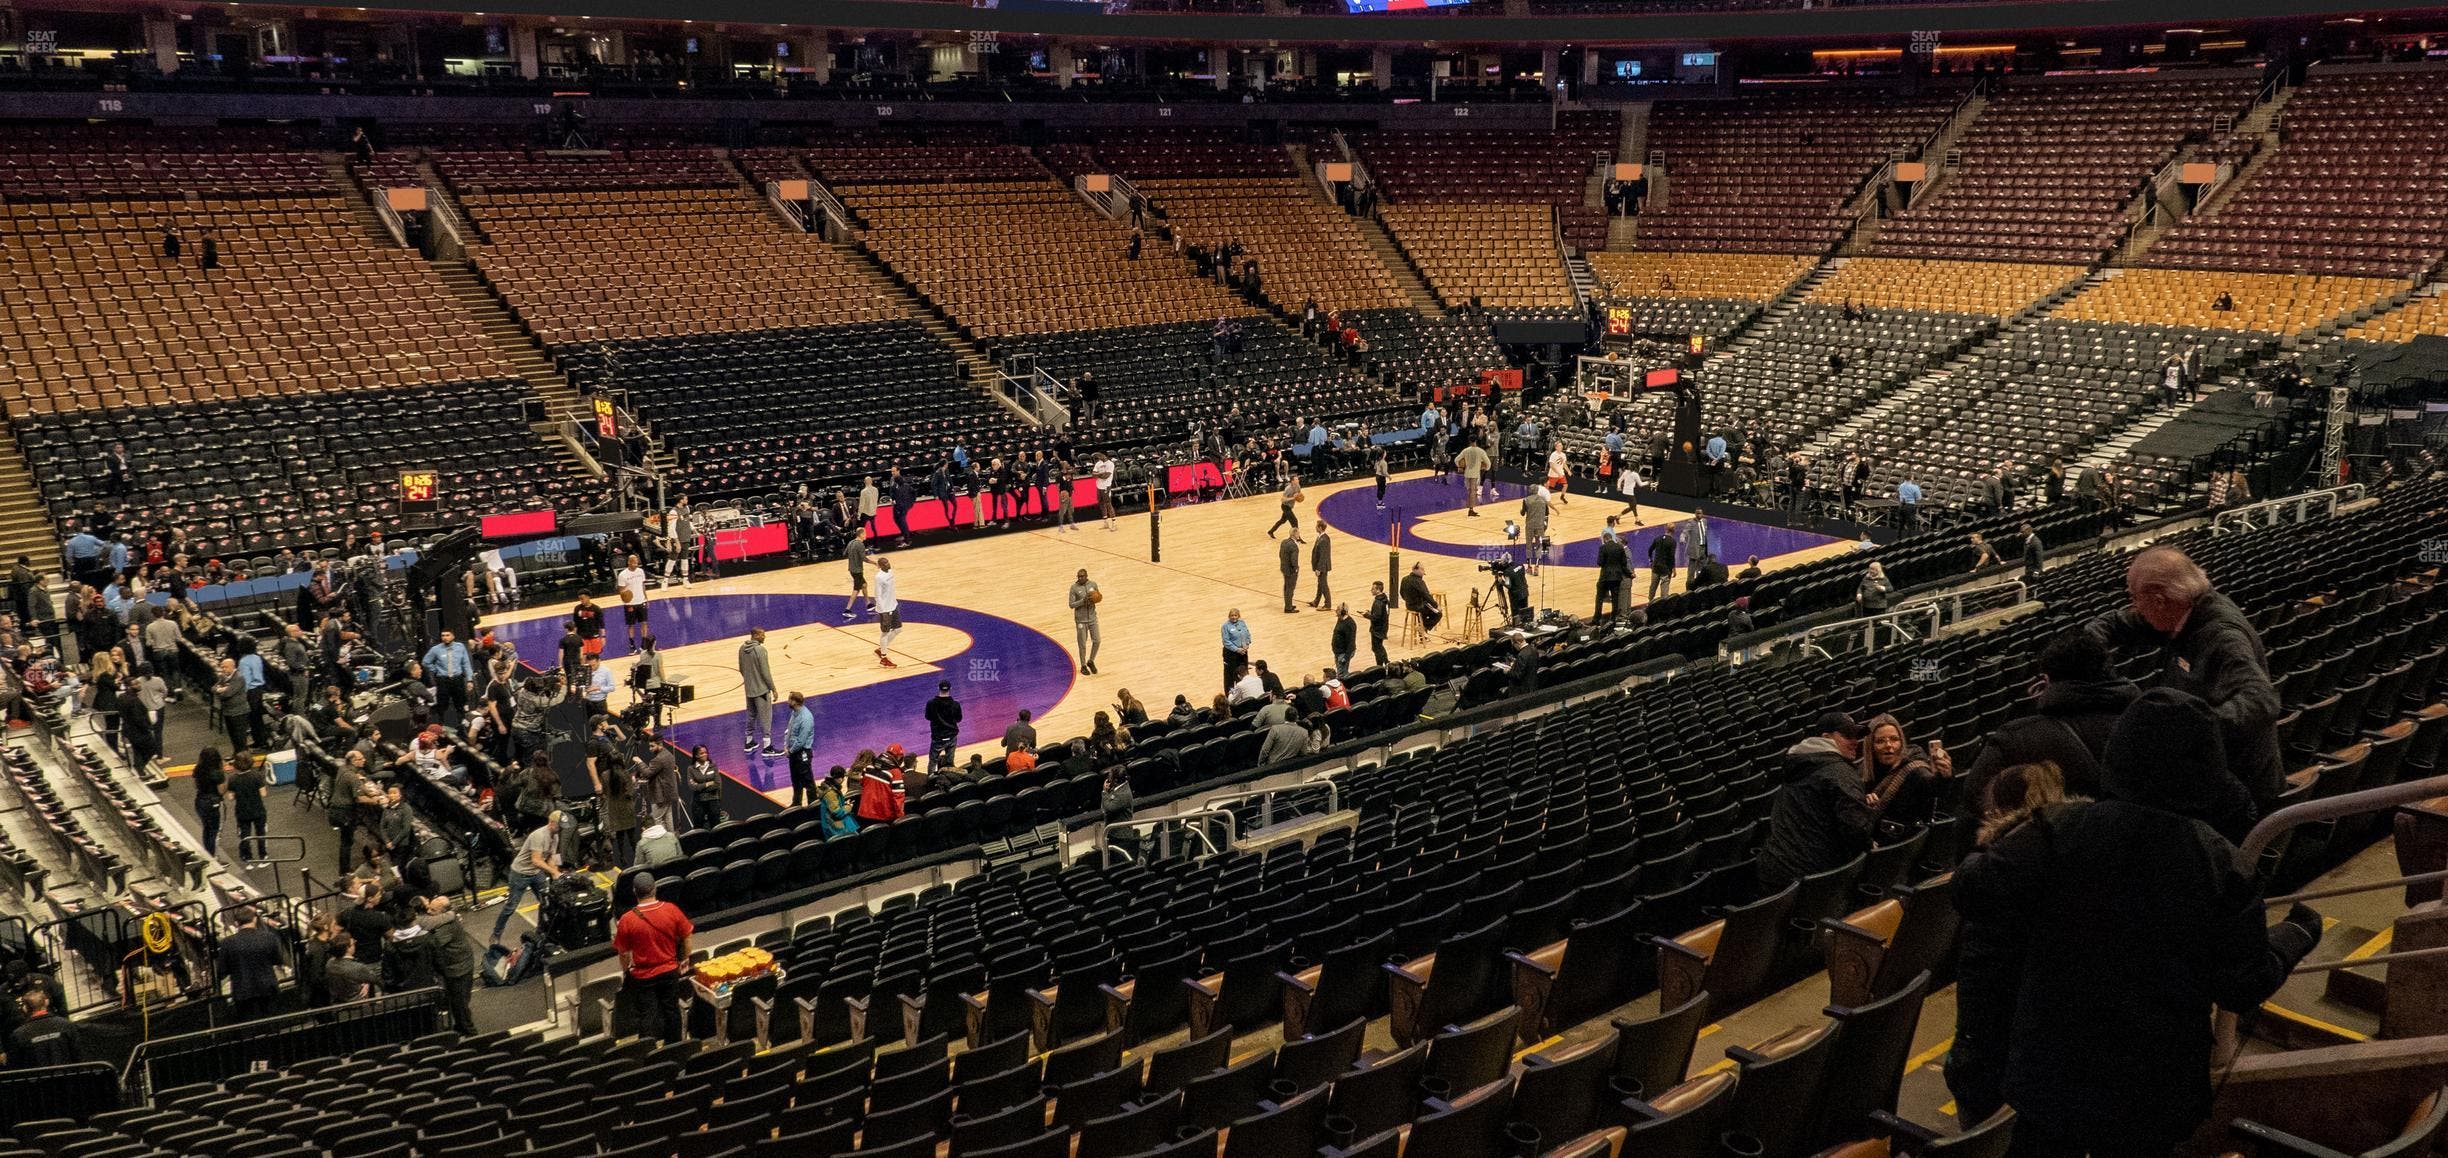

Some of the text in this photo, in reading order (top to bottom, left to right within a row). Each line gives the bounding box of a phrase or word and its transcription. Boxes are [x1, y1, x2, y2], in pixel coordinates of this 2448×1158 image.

[100, 100, 122, 111] 118
[534, 104, 551, 114] 119
[877, 107, 892, 116] 120
[1159, 108, 1171, 117] 121
[1454, 108, 1469, 116] 122
[1610, 319, 1629, 333] 24
[599, 414, 616, 435] 24
[403, 475, 432, 487] 8:26
[408, 487, 428, 499] 24
